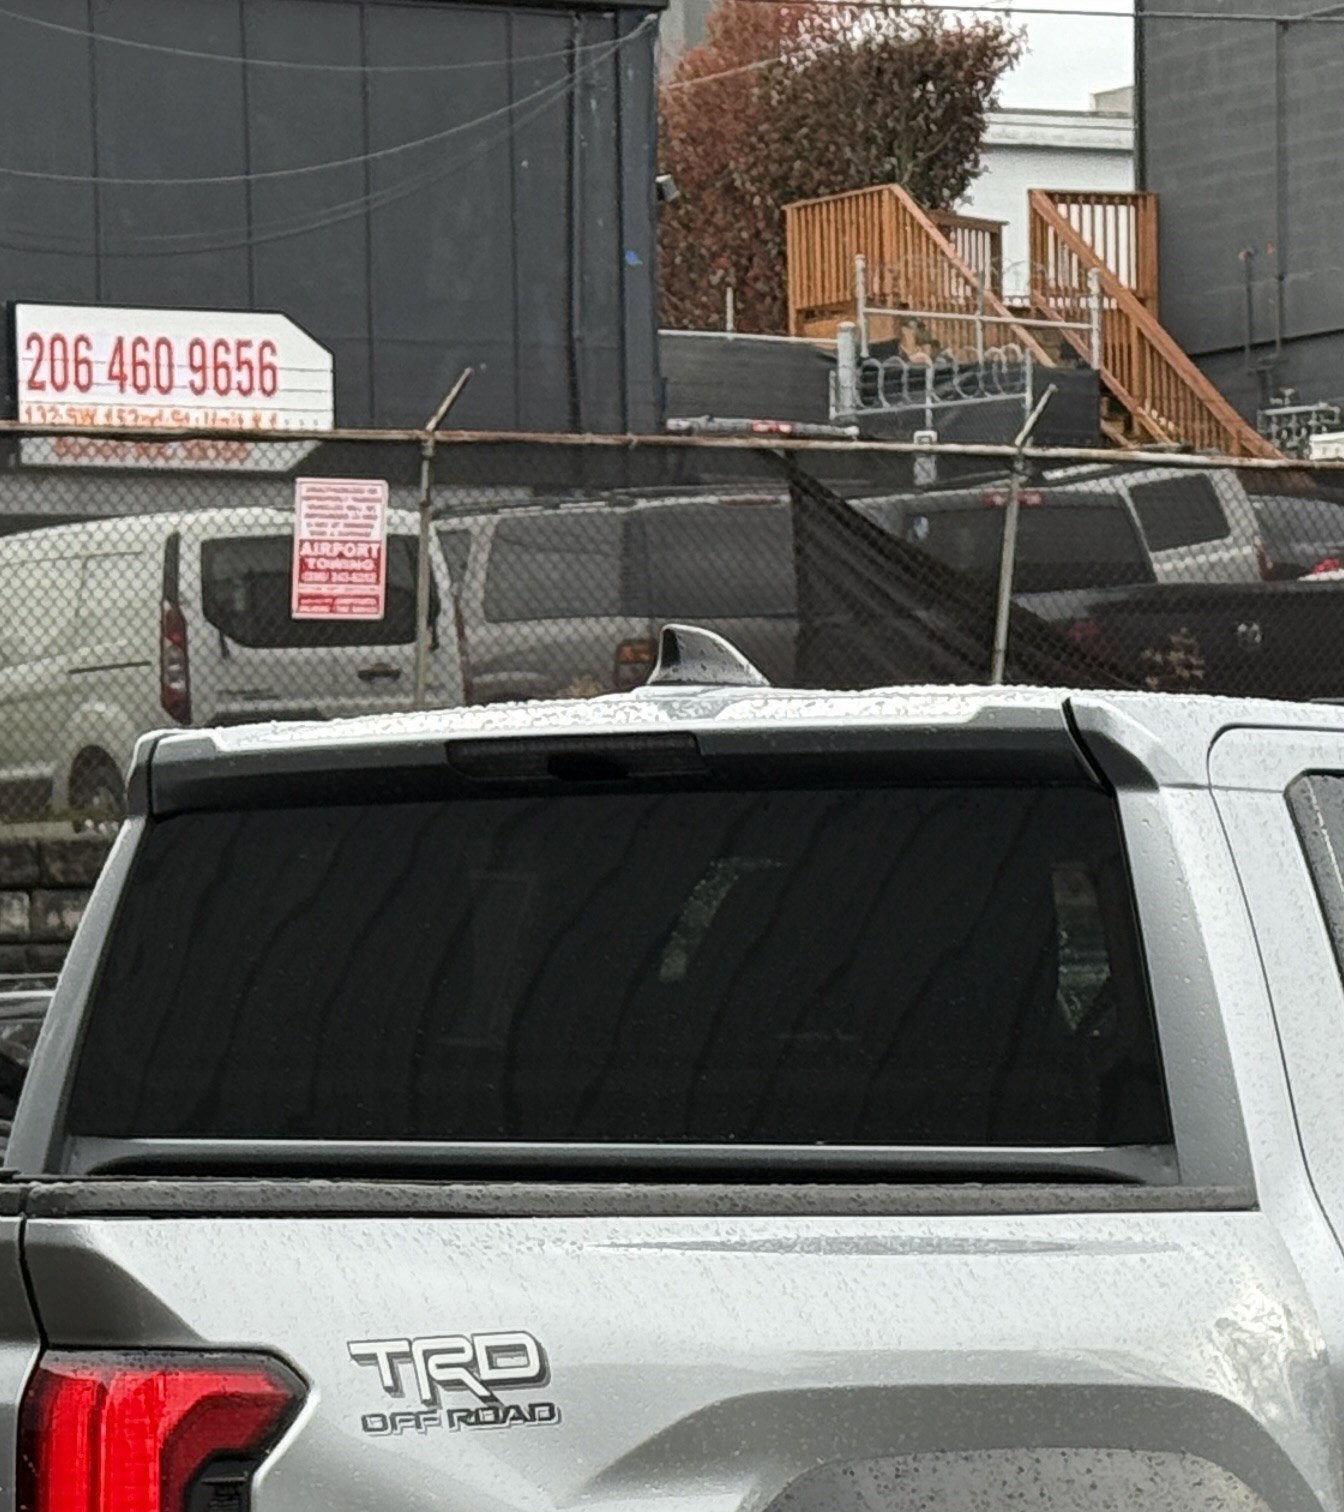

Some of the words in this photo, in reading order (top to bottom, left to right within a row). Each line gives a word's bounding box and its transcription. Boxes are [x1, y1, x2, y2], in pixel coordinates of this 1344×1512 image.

[26, 332, 93, 392] 206
[108, 336, 174, 395] 460
[188, 337, 278, 398] 9656
[299, 540, 381, 558] AIRPORT
[346, 1330, 551, 1408] TRD
[360, 1408, 443, 1436] OFF
[446, 1401, 562, 1433] ROAD
